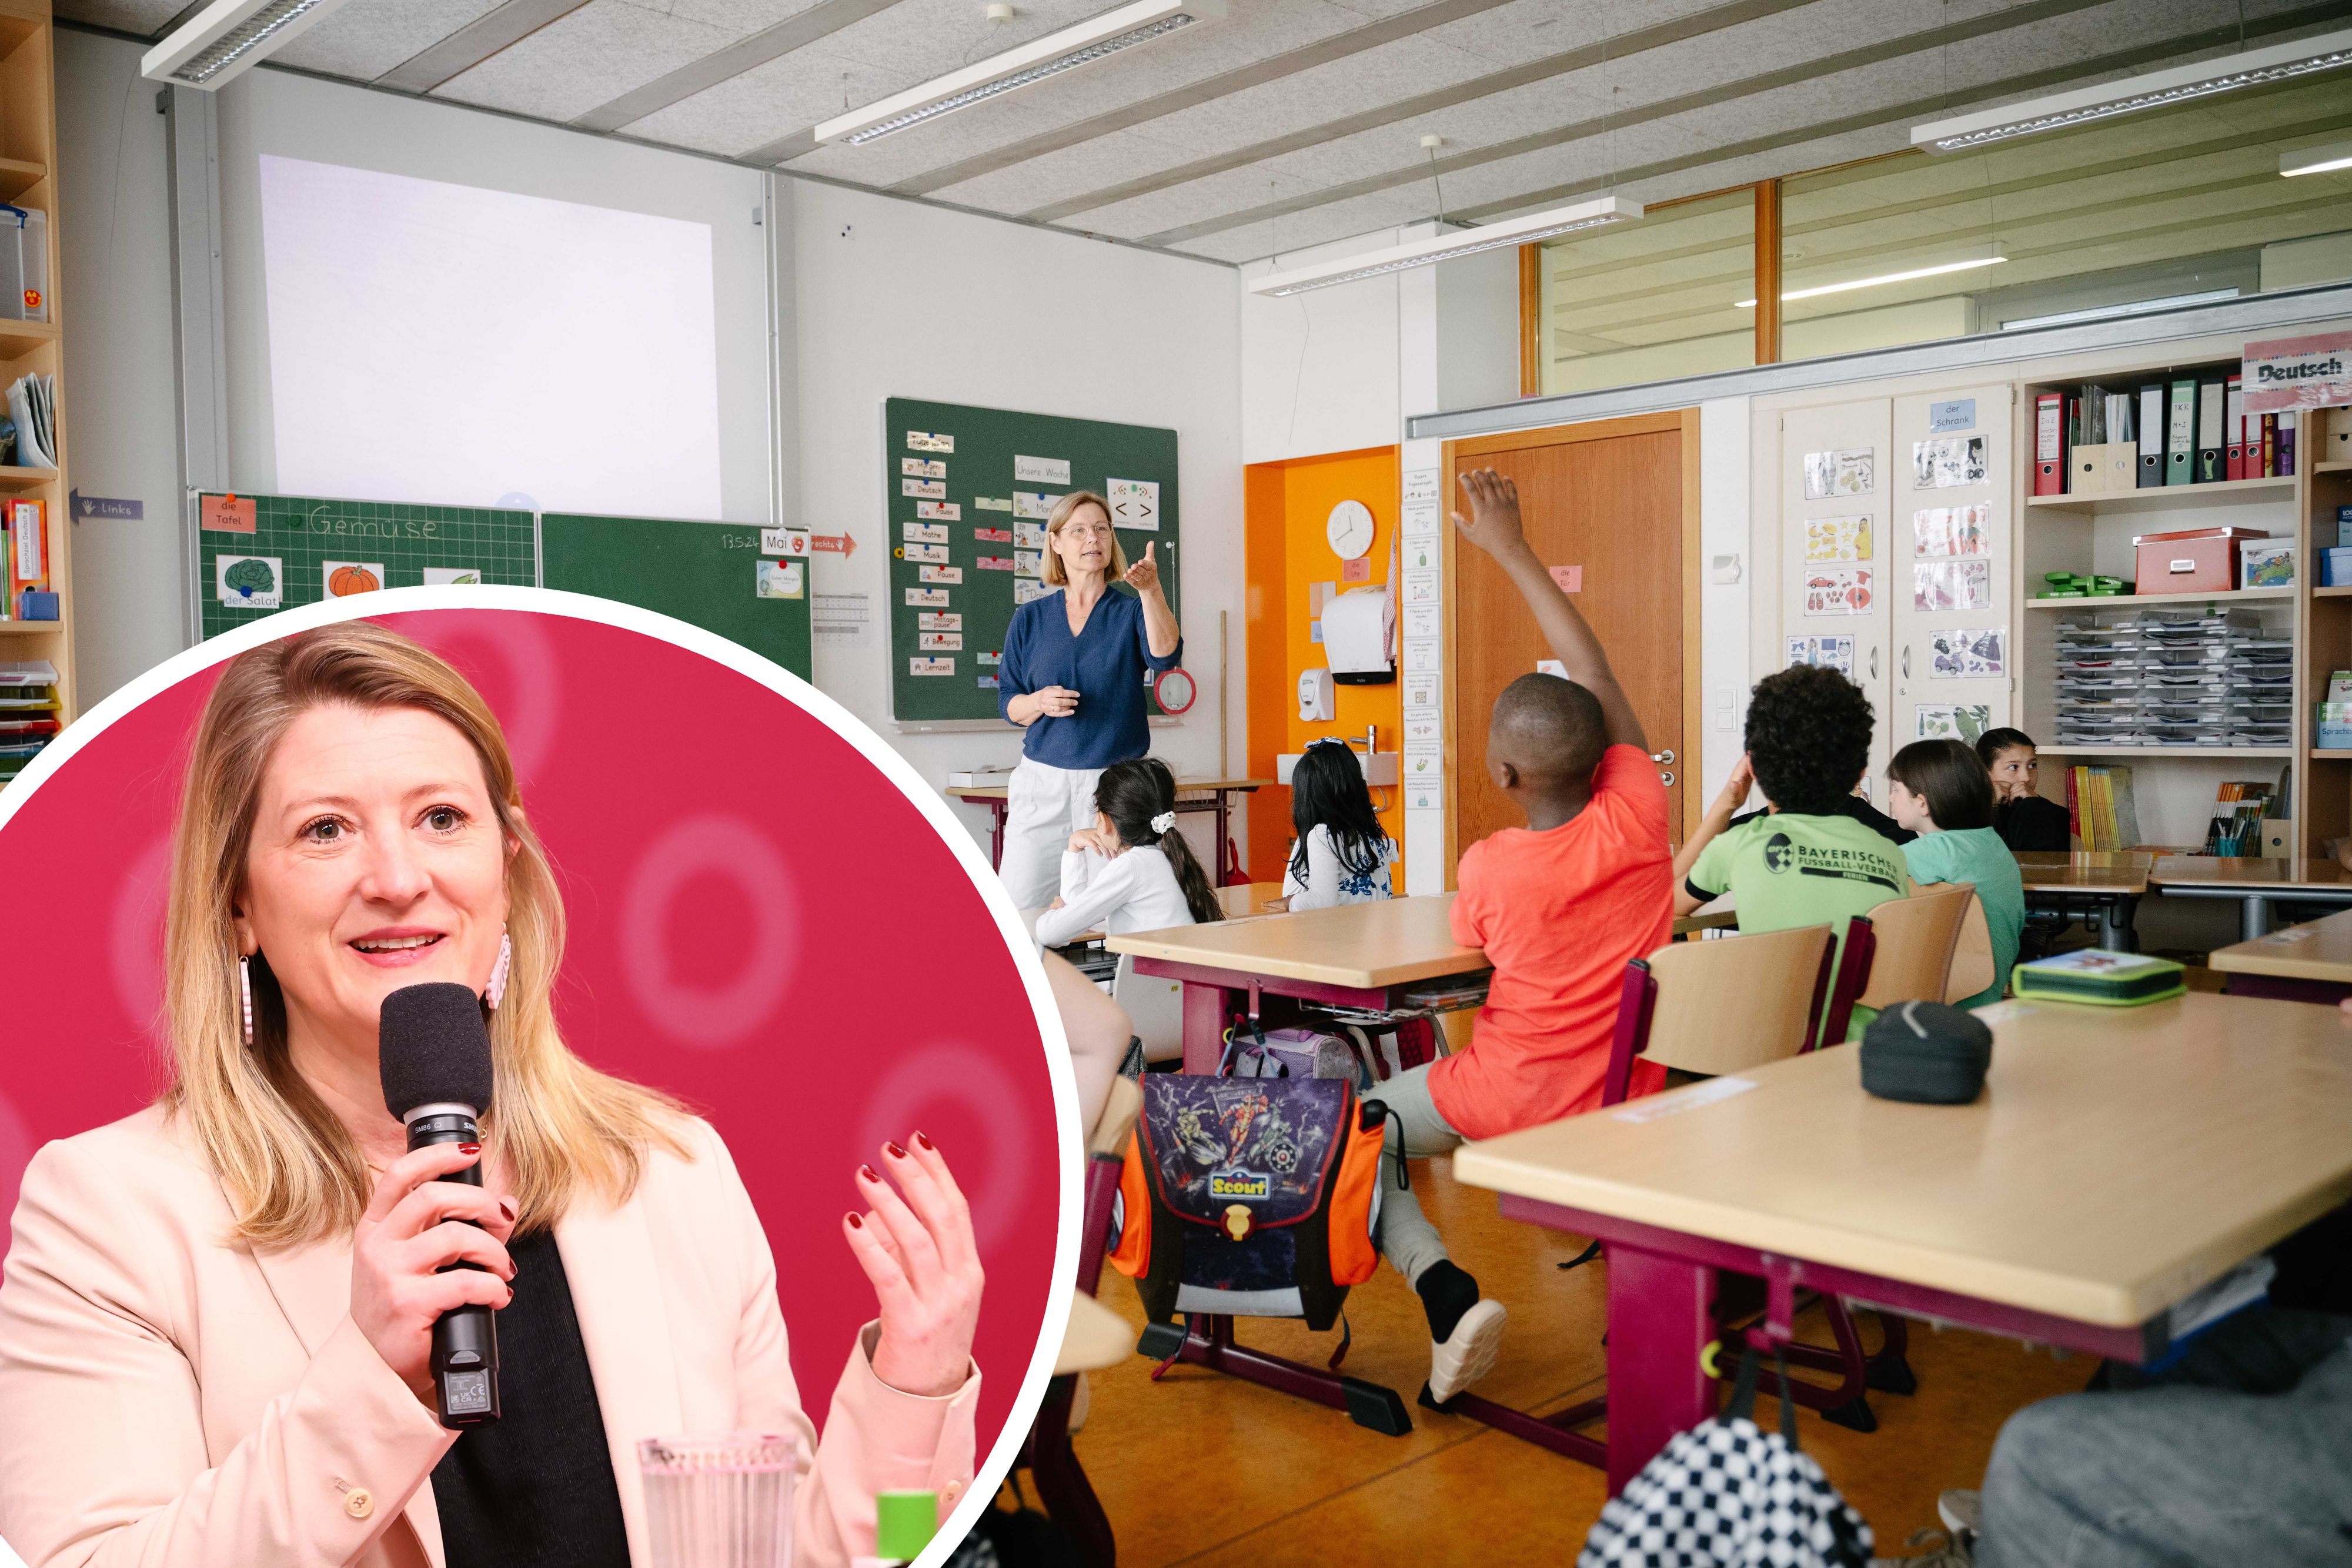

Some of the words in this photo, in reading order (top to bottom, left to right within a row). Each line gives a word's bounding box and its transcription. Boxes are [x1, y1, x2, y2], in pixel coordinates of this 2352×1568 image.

[2258, 357, 2343, 383] Deutsch
[1937, 416, 1969, 427] Schrank
[1017, 466, 1041, 476] Unsere
[1045, 468, 1069, 479] Woche
[918, 486, 942, 494] Deutsch
[221, 502, 236, 510] die
[936, 507, 954, 516] Pause
[216, 514, 242, 525] Tafel
[310, 505, 439, 539] Gemüse
[721, 534, 759, 549] 13.5.24
[767, 536, 787, 549] Mai
[924, 551, 941, 559] Musik
[225, 595, 243, 604] der
[247, 596, 278, 606] Salat
[933, 638, 960, 647] Bewegung
[1798, 845, 1897, 874] BAYERISCHER
[415, 1124, 431, 1134] SM86
[1213, 1178, 1266, 1195] Scout
